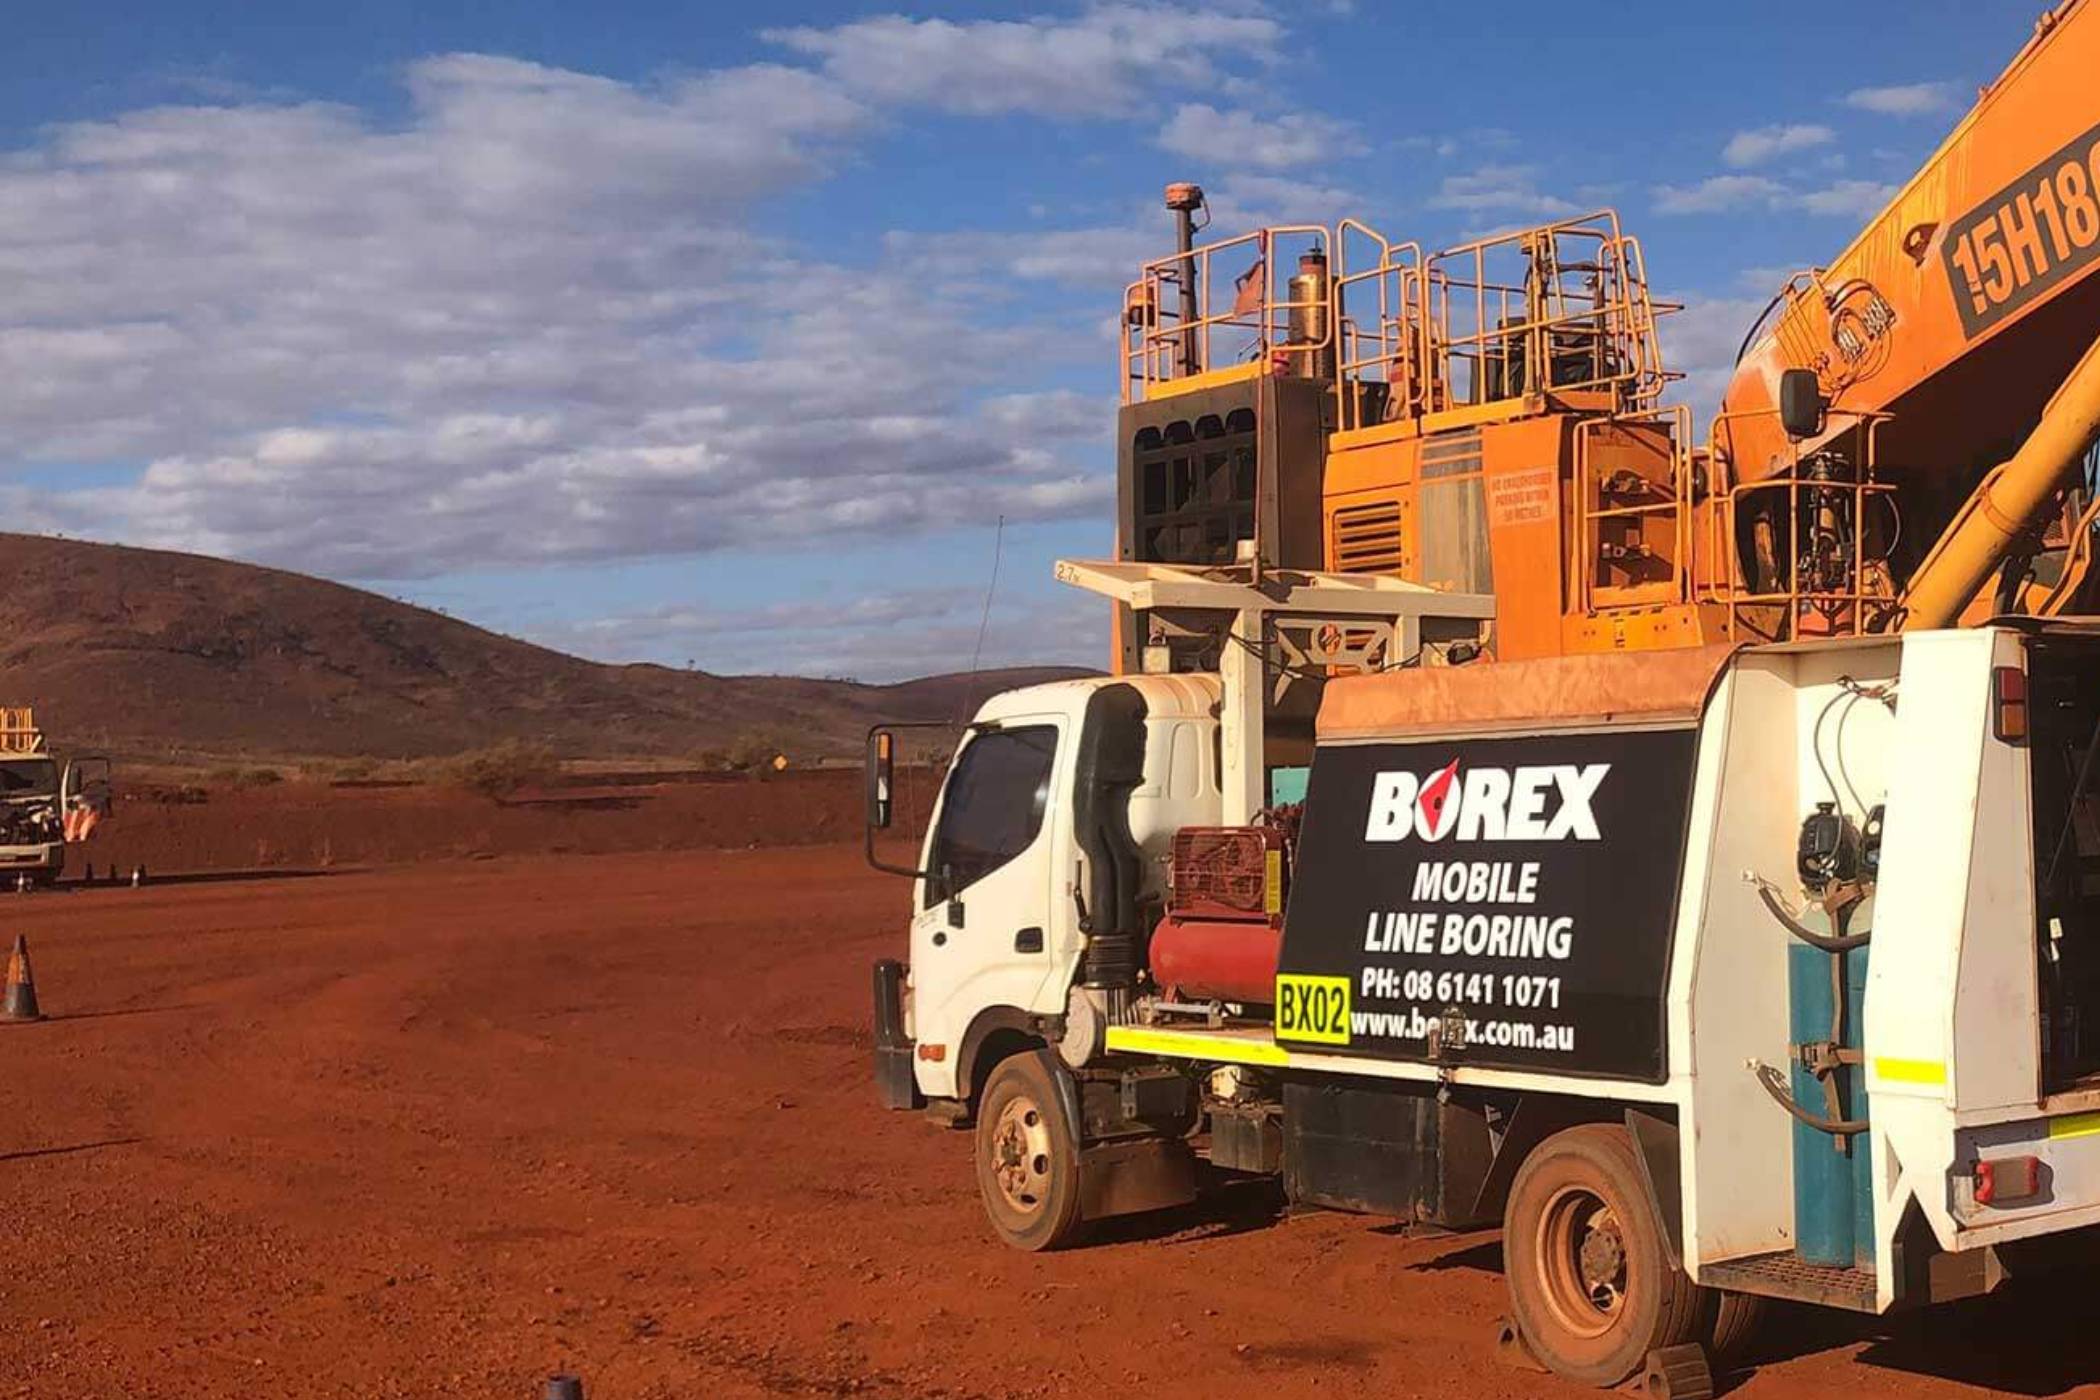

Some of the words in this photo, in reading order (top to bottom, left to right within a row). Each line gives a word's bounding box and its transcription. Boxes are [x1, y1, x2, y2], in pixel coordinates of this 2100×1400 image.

[1952, 140, 2100, 316] 15H18
[1365, 762, 1612, 843] BOREX
[1411, 861, 1540, 904] MOBILE
[1364, 911, 1438, 954] LINE
[1440, 913, 1574, 960] BORING
[1280, 982, 1345, 1035] BX02
[1361, 966, 1400, 999] PH:
[1403, 969, 1433, 1001] 08
[1436, 971, 1495, 1004] 6141
[1502, 975, 1561, 1009] 1071
[1350, 1006, 1575, 1051] www.box.com.au
